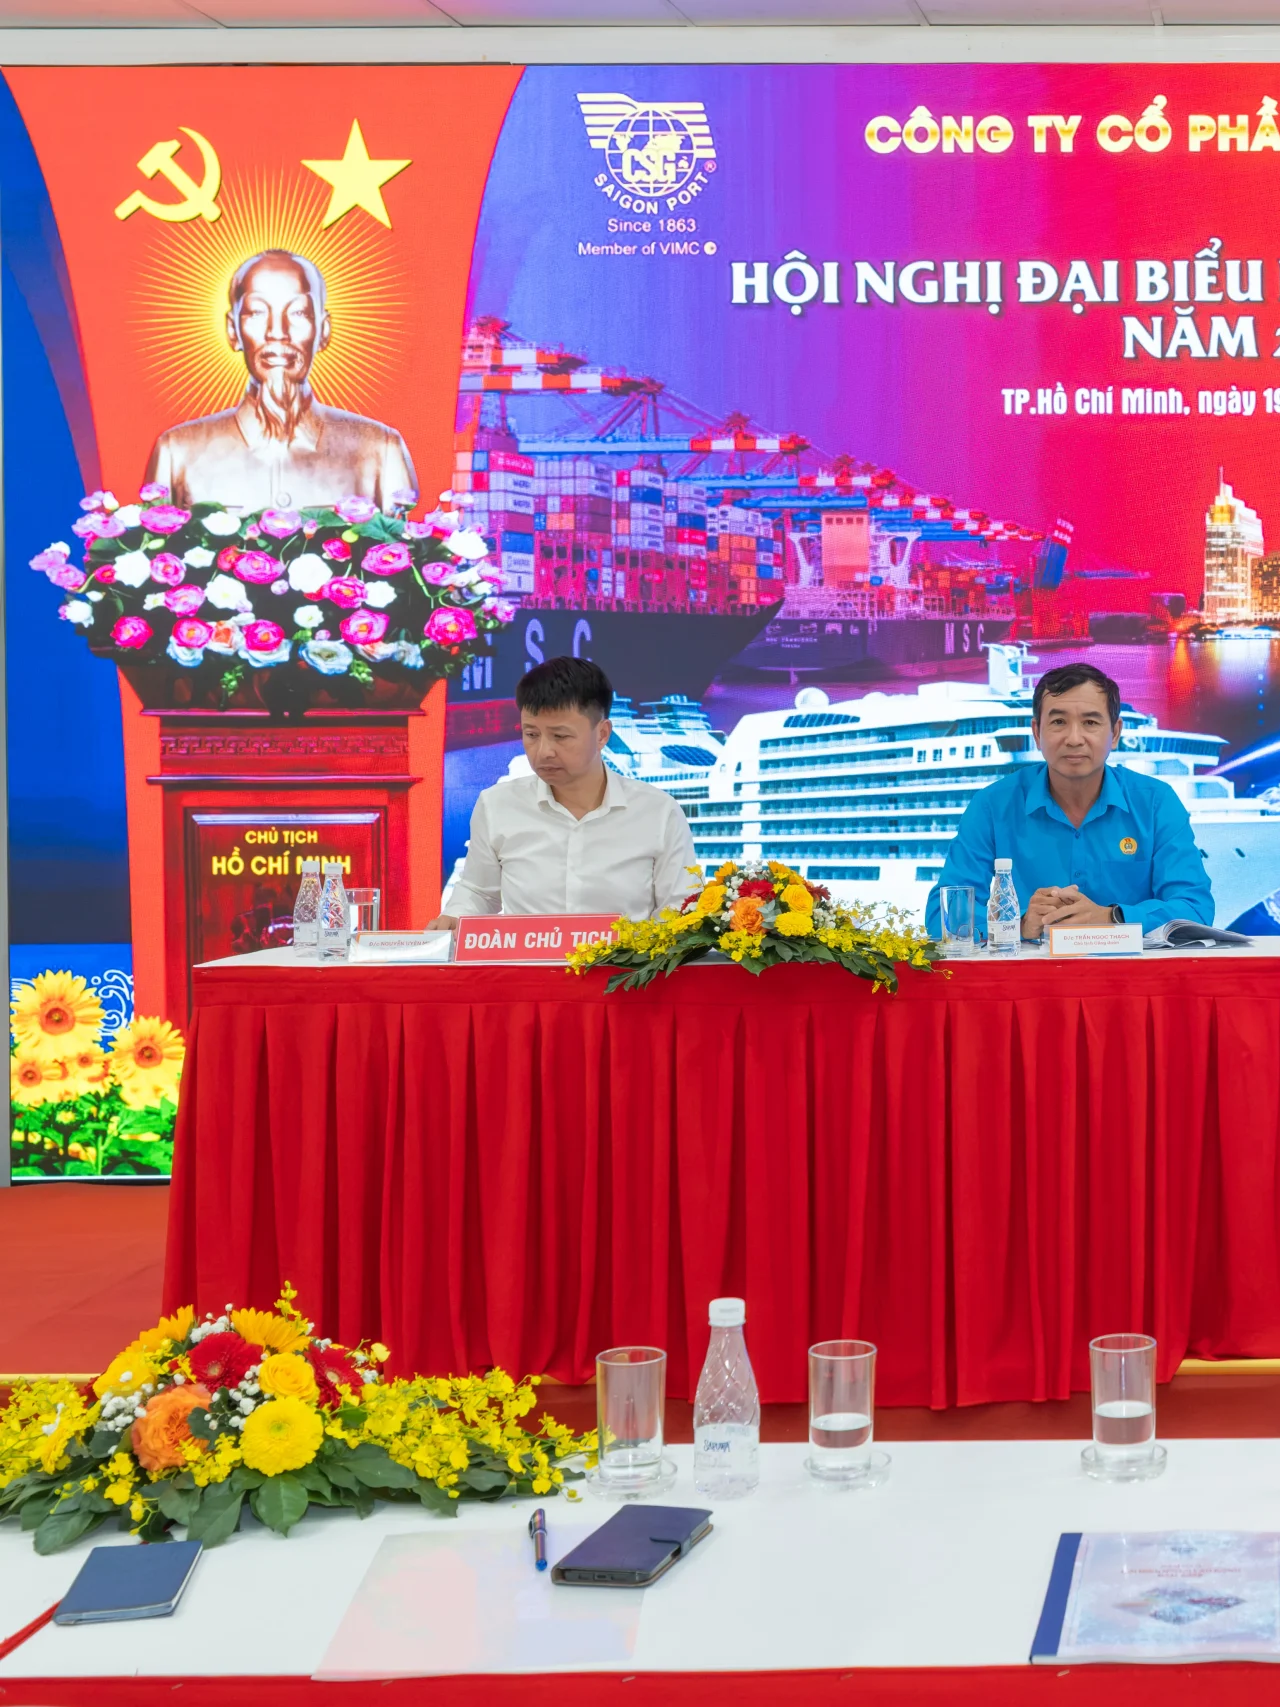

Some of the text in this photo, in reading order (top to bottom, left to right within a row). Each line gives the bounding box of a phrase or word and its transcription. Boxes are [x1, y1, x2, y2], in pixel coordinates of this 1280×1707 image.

[864, 105, 1015, 154] CÔNG
[1027, 114, 1083, 154] TY
[1096, 94, 1173, 154] CỔ
[593, 171, 709, 215] SAIGON PORT
[607, 218, 697, 233] Since 1863
[578, 241, 700, 256] Member of VIMC
[730, 249, 839, 316] HỘI
[854, 260, 1002, 316] NGHỊ
[1016, 259, 1121, 315] ĐẠI
[1135, 237, 1263, 302] BIỂU
[1122, 306, 1259, 359] NĂM
[1001, 381, 1068, 416] TP.Hồ
[1075, 385, 1114, 415] Chí
[1121, 387, 1191, 416] Minh,
[1198, 385, 1257, 416] ngày
[245, 826, 318, 847] CHỦ TỊCH
[211, 846, 245, 876] HỒ
[250, 850, 291, 876] CHÍ
[464, 929, 517, 949] ĐOÀN
[524, 926, 563, 948] CHỦ
